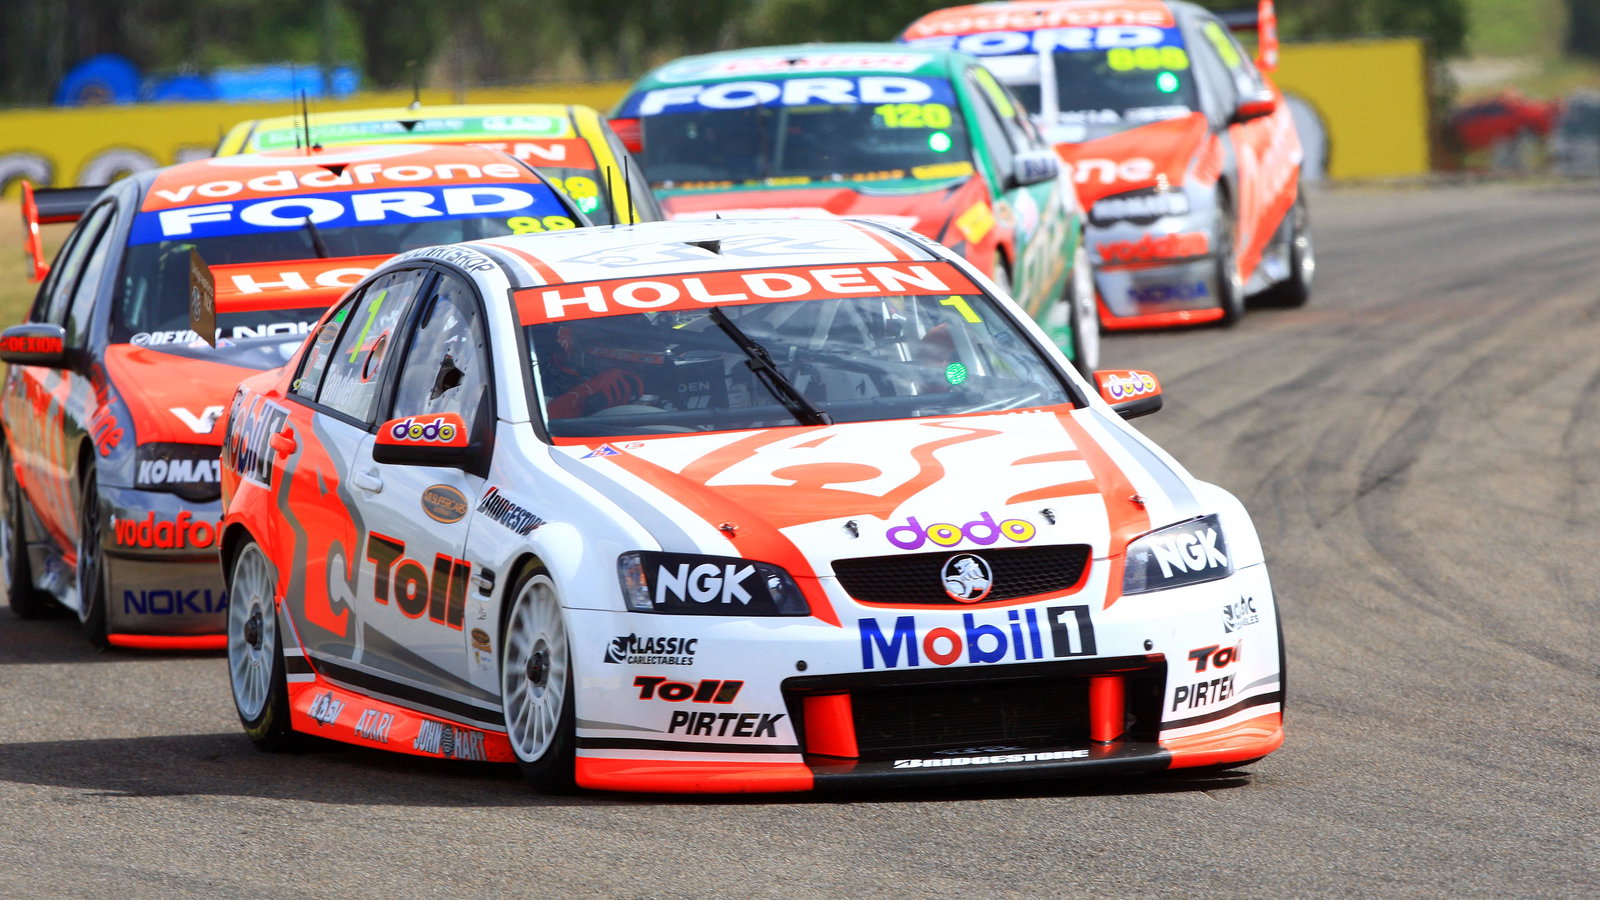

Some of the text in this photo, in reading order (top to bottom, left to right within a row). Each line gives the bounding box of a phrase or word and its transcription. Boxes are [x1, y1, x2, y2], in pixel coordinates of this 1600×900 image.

[640, 76, 933, 116] FORD
[875, 103, 953, 128] 120
[154, 162, 521, 204] vodafone
[158, 187, 535, 237] FORD
[231, 267, 375, 296] HO
[541, 264, 952, 319] HOLDEN
[349, 290, 388, 364] 1
[938, 295, 983, 324] 1
[1109, 372, 1156, 399] dodo
[391, 418, 456, 442] dodo
[885, 510, 1037, 551] dodo
[1150, 527, 1229, 579] NGK
[367, 530, 472, 632] Toll
[655, 563, 757, 606] NGK
[629, 636, 699, 656] CLASSIC
[858, 607, 1089, 669] Mobil 1
[627, 655, 694, 666] CARLECTABLES
[632, 675, 745, 705] Toll
[354, 708, 396, 744] ATARI
[413, 718, 488, 762] JOHN HART
[667, 710, 786, 738] PIRTEK
[892, 749, 1090, 769] BRIDGESTONE
